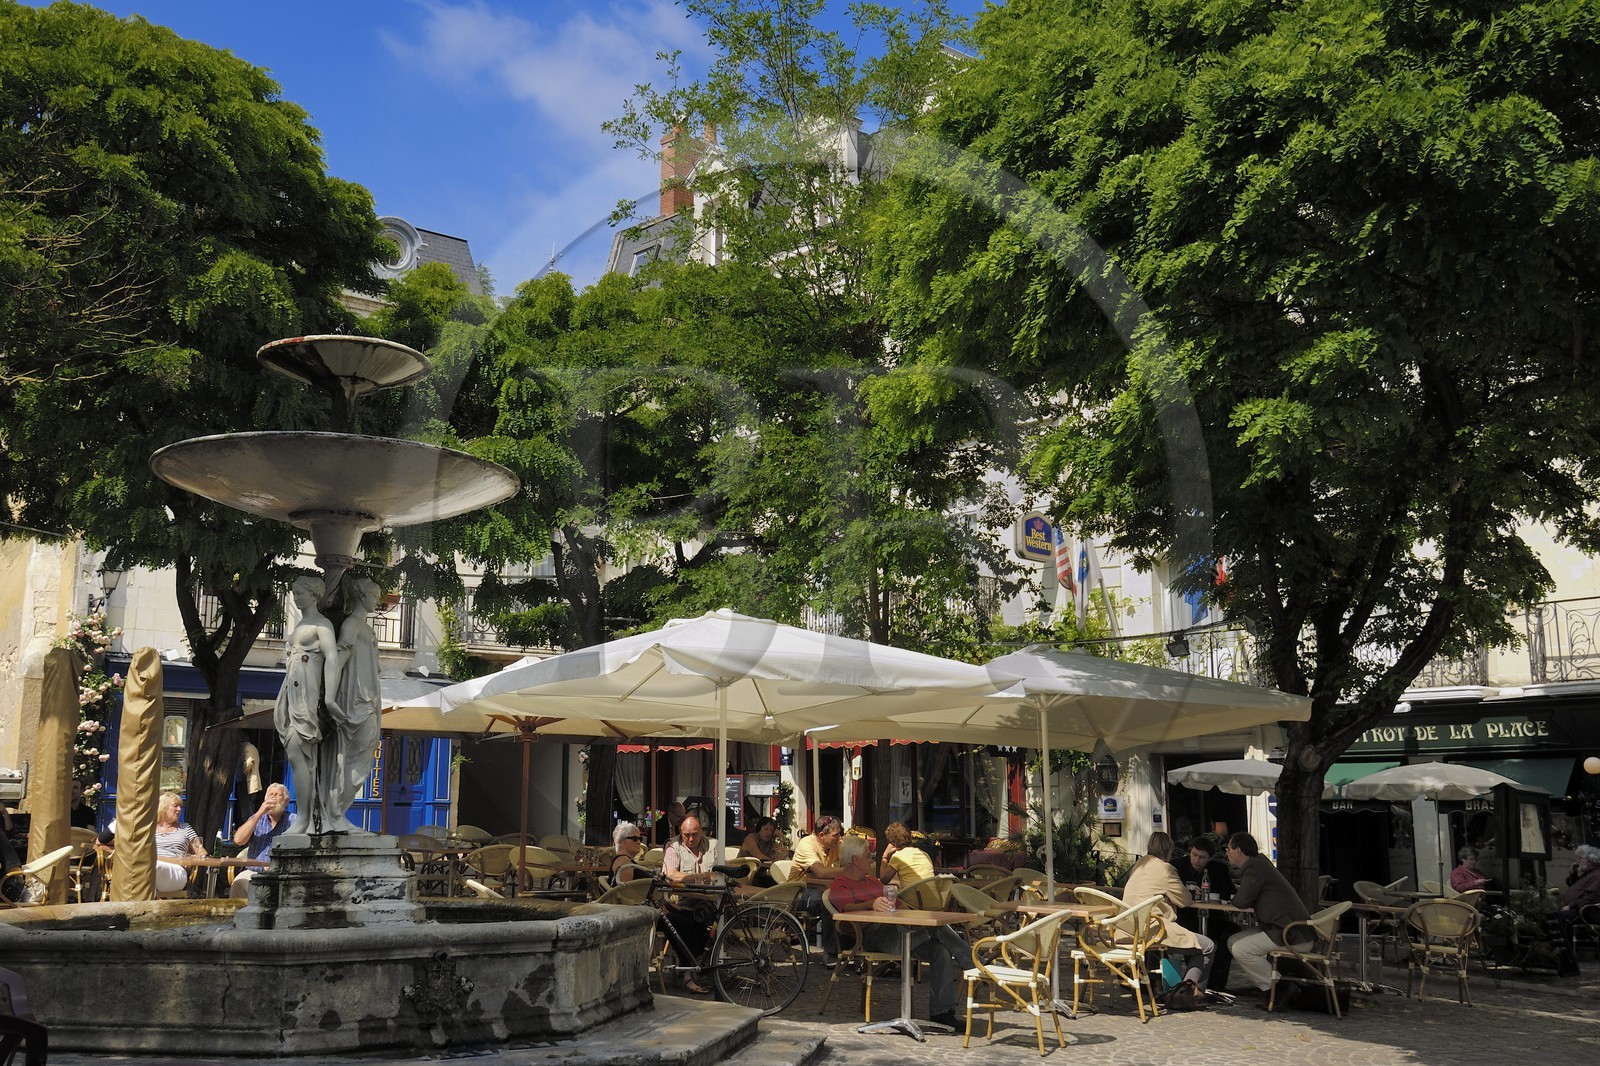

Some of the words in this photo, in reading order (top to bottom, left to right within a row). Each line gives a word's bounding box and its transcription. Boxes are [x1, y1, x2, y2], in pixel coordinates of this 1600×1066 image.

[1031, 528, 1045, 541] Best
[1025, 536, 1051, 550] Western
[1354, 726, 1405, 743] TROT
[1413, 725, 1439, 741] DE
[1449, 723, 1474, 740] LA
[1485, 720, 1549, 739] PLACE
[1332, 800, 1353, 810] BAR
